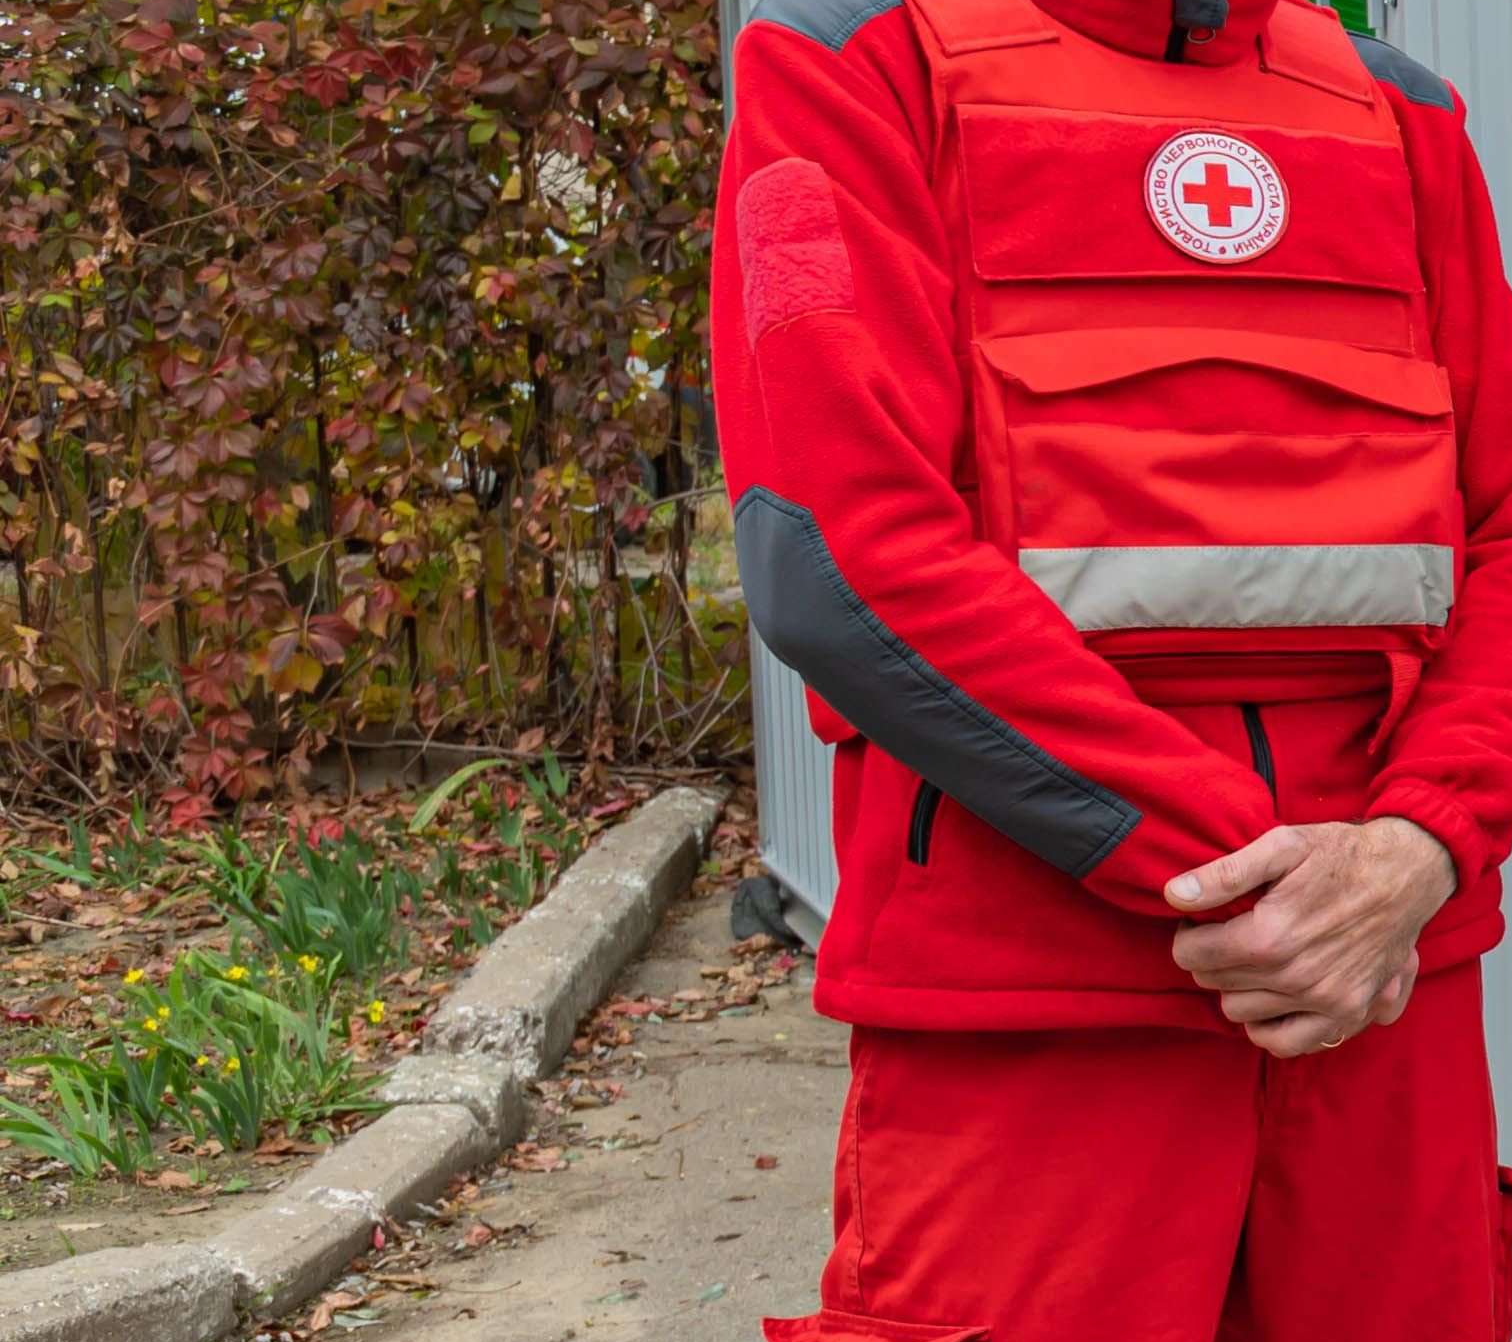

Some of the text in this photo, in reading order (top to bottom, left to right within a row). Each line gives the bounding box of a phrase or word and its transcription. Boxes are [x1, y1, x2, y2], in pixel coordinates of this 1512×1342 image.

[1154, 137, 1280, 255] ТОВАРИСТВО ЧЕРВОНОГО ХРЕСТА УКРАЇНИ
